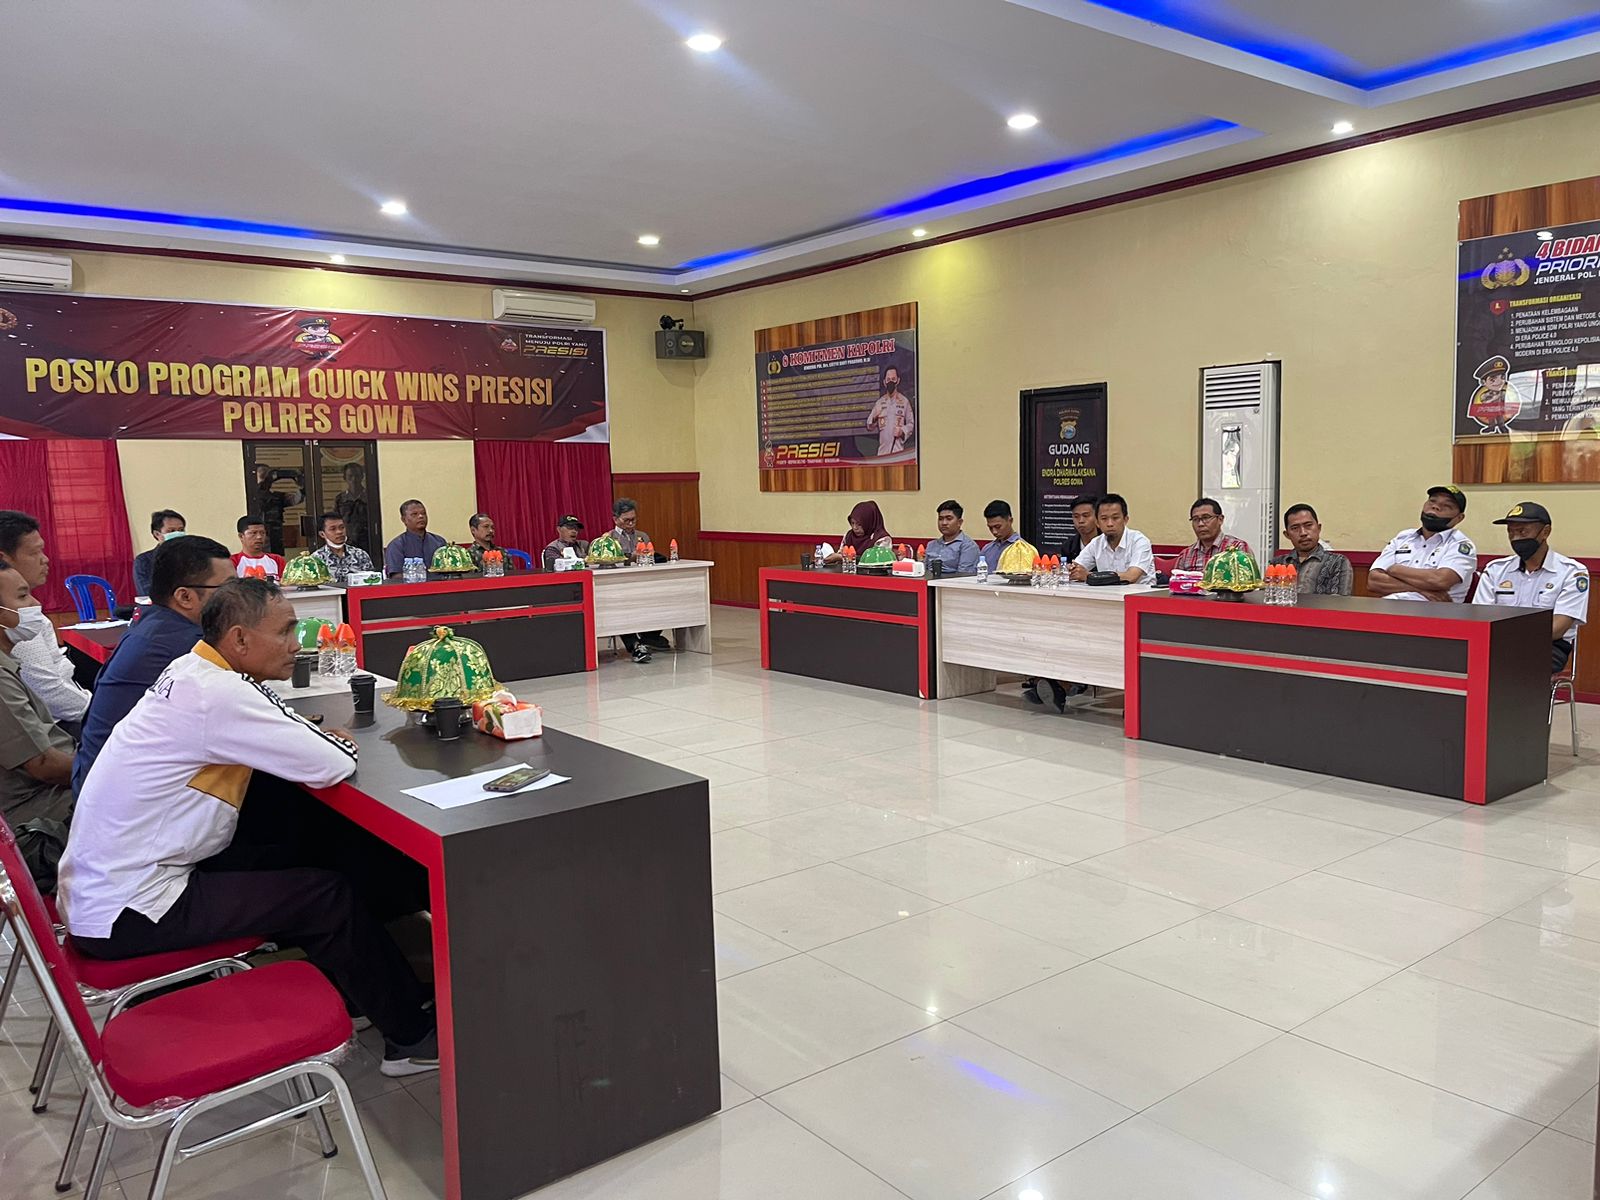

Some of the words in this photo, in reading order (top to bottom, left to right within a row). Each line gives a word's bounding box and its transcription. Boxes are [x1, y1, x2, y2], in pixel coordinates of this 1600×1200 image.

[1535, 241, 1552, 260] 4
[1534, 273, 1576, 285] JENDERAL
[1577, 271, 1597, 280] POL.
[1509, 296, 1548, 307] TRANSFORMASI
[1549, 293, 1581, 303] ORGANISASI
[1515, 310, 1540, 318] PENATAAN
[1541, 306, 1578, 315] KELEMBAGAAN
[1515, 316, 1545, 326] PERUBAHAN
[1545, 314, 1564, 324] SISTEM
[1564, 313, 1575, 322] DAN
[1515, 325, 1546, 335] MENJADIKAN
[1546, 323, 1558, 331] SDM
[1558, 321, 1574, 330] POLRI
[1573, 320, 1588, 328] YANG
[1531, 332, 1550, 340] POLICE
[1514, 339, 1545, 349] PERUBAHAN
[1545, 337, 1574, 347] TEKNOLOGI
[523, 345, 589, 356] PRESISI
[782, 354, 789, 367] 8
[790, 346, 846, 366] KOMITMEN
[847, 338, 896, 359] KAPOLRI
[1514, 348, 1536, 358] MODERN
[1535, 348, 1542, 356] DI
[1541, 347, 1552, 355] ERA
[1552, 346, 1571, 355] POLICE
[25, 357, 139, 394] POSKO
[148, 361, 301, 398] PROGRAM
[308, 367, 388, 400] QUICK
[395, 371, 459, 402] WINS
[466, 375, 553, 406] PRESISI
[222, 401, 332, 434] POLRES
[339, 403, 417, 435] GOWA
[776, 442, 840, 459] PRESISI
[1048, 443, 1090, 455] GUDANG
[1053, 478, 1070, 486] POLRES
